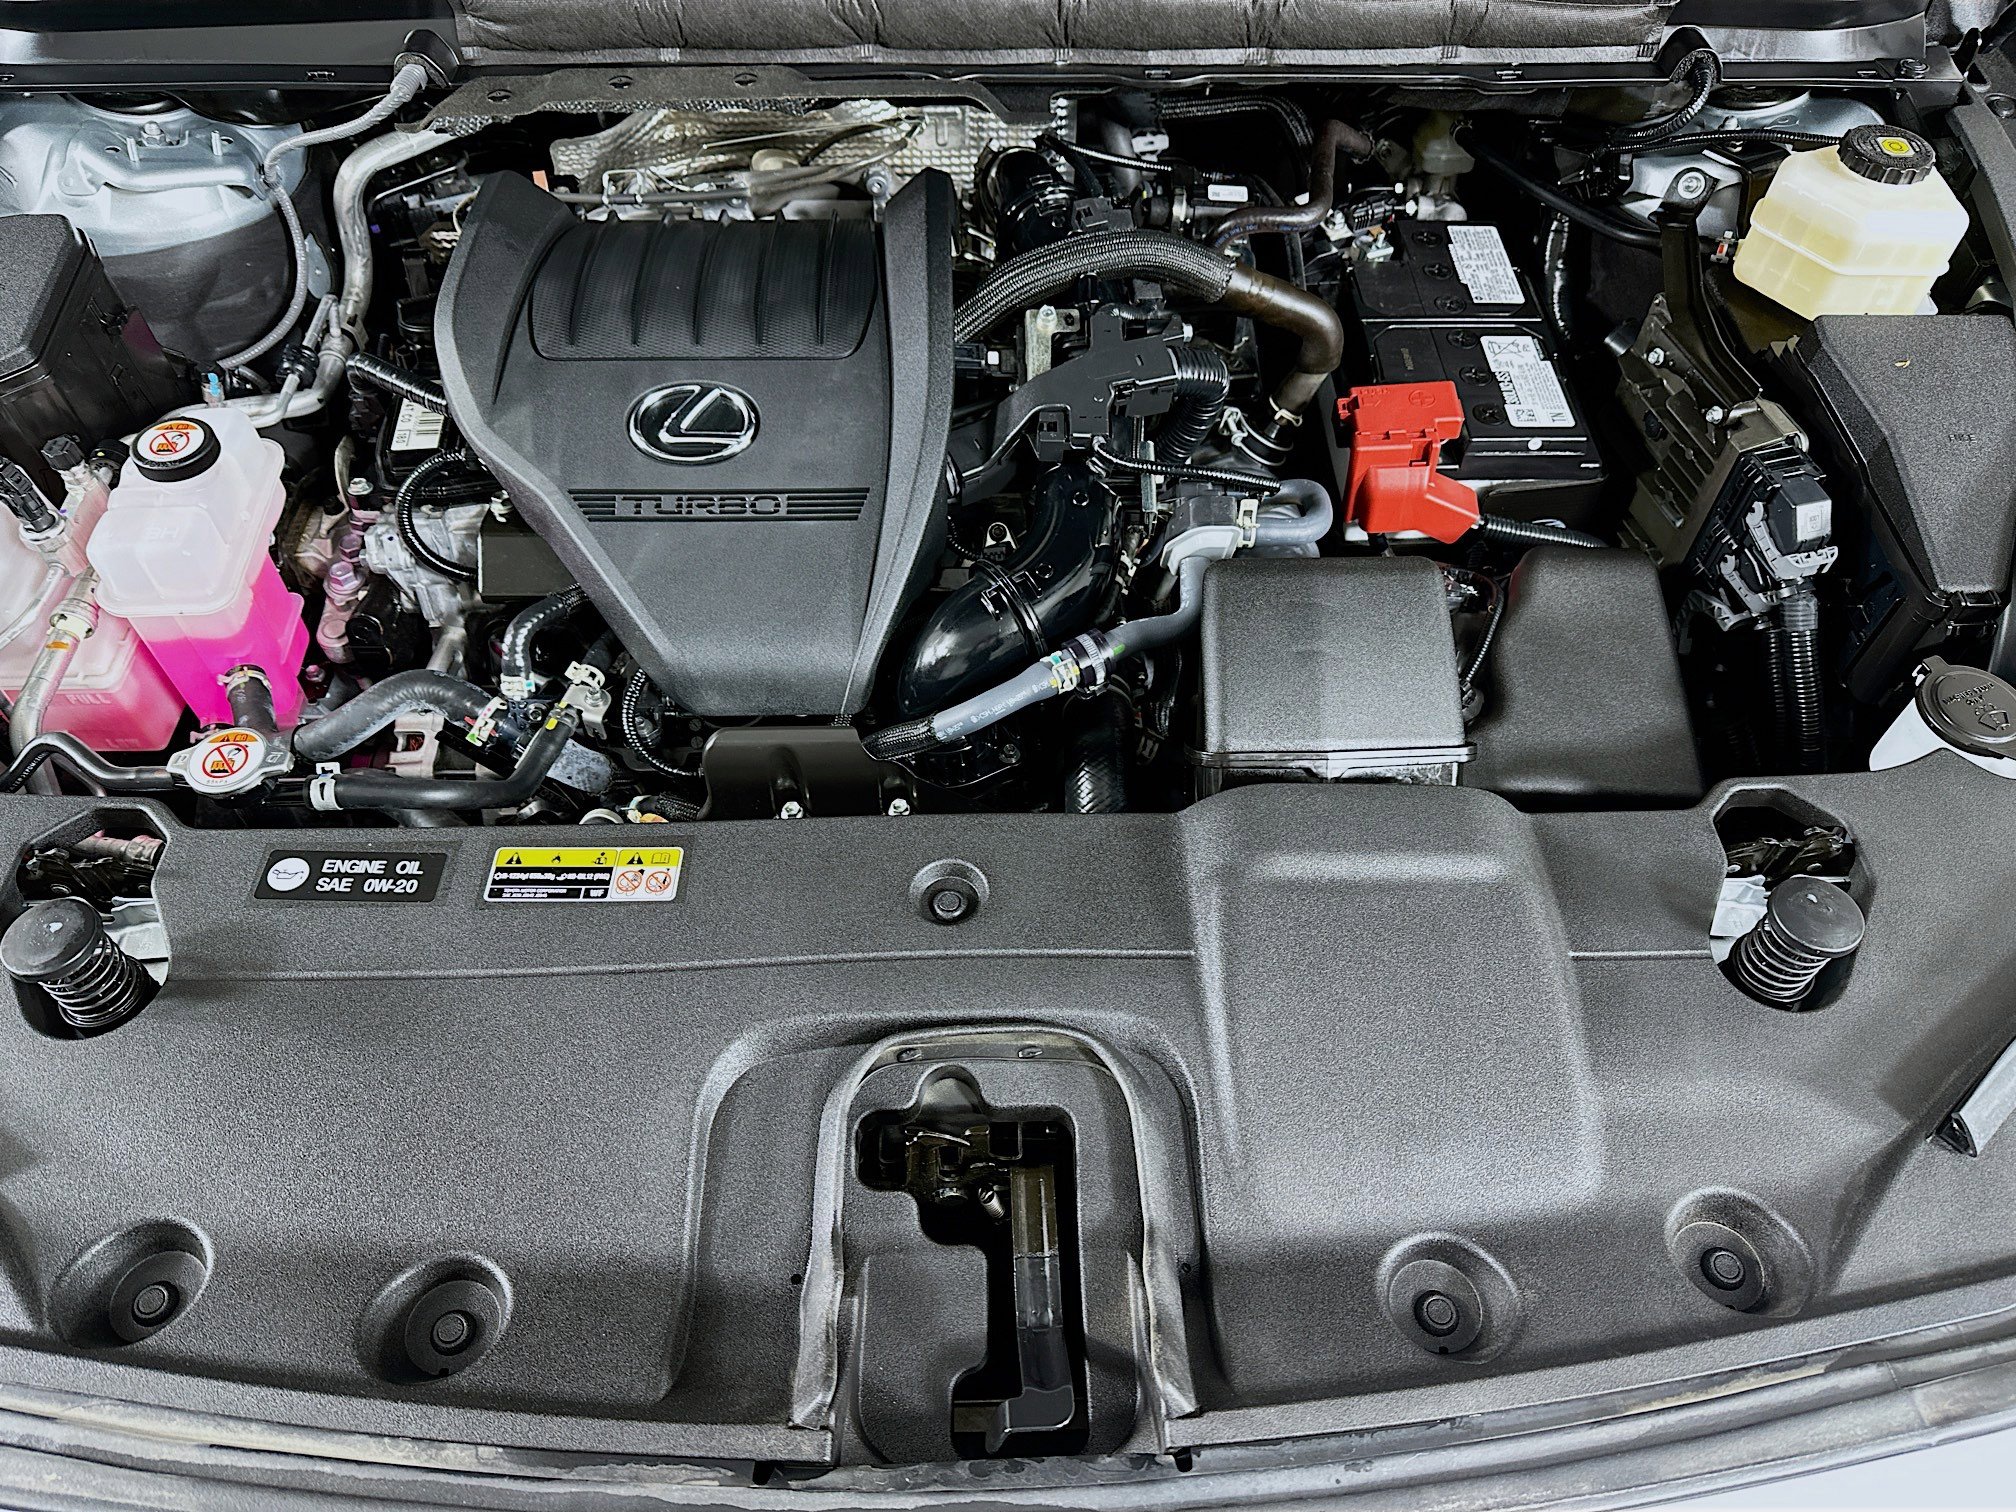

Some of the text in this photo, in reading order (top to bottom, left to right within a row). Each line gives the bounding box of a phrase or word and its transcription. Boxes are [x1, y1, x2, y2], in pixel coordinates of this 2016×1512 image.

[621, 495, 782, 516] TURBO
[65, 693, 112, 705] FULL
[321, 859, 424, 875] ENGINE OIL
[315, 877, 419, 894] SAE 0W-20
